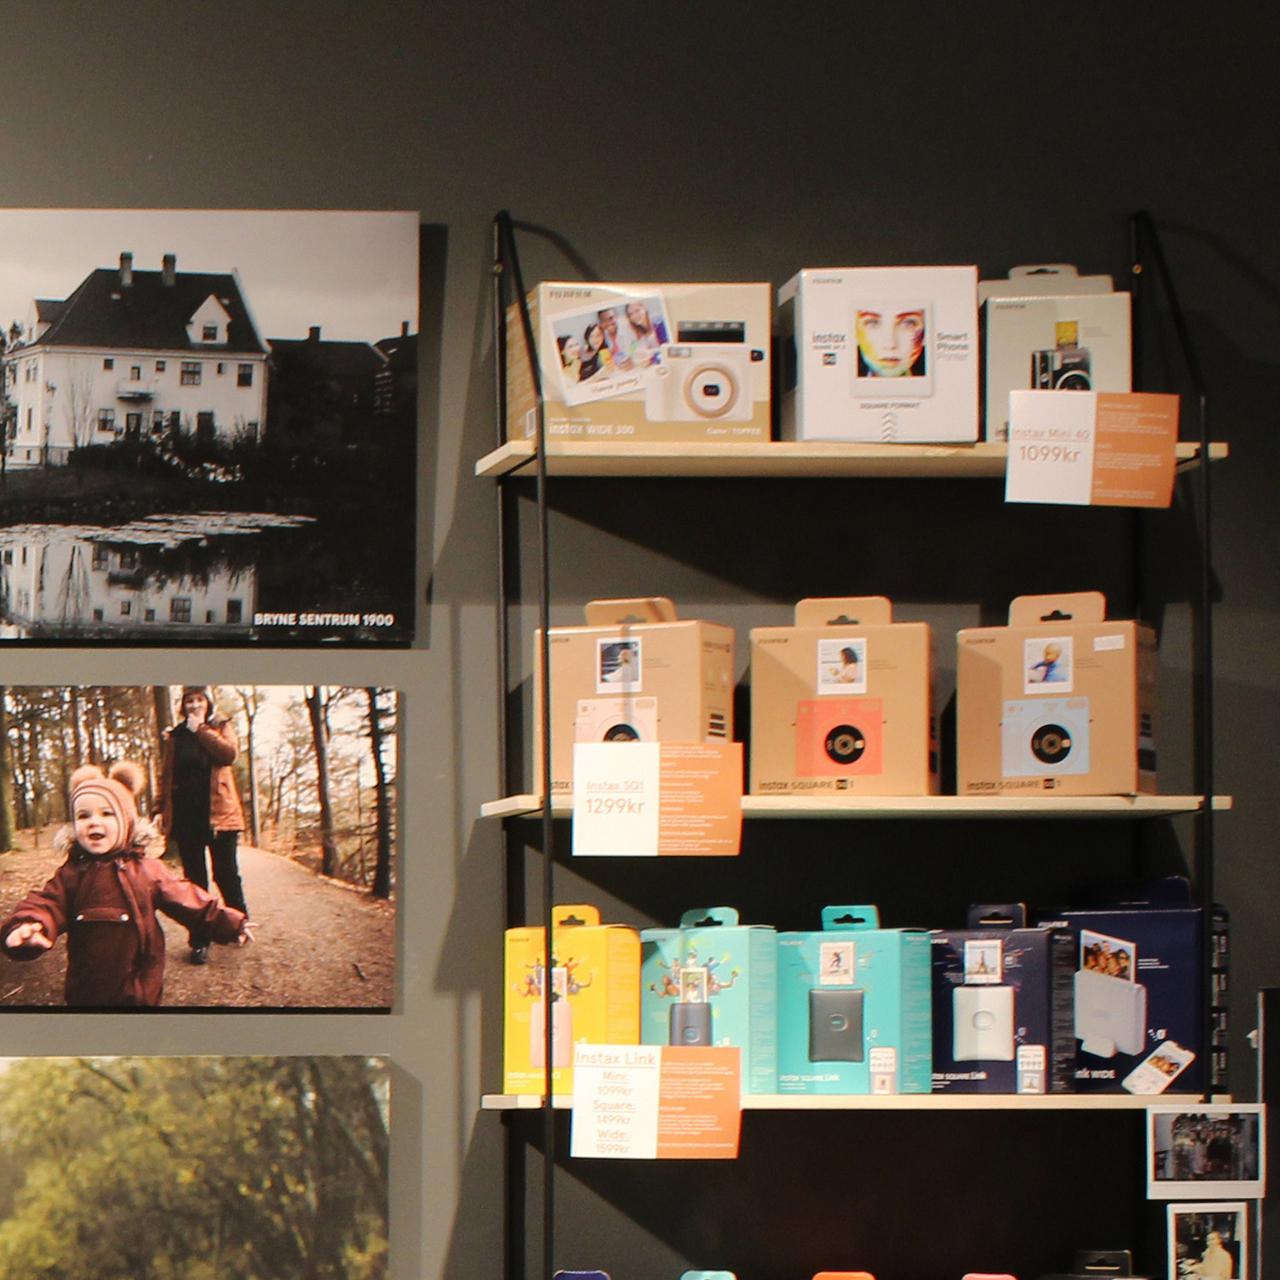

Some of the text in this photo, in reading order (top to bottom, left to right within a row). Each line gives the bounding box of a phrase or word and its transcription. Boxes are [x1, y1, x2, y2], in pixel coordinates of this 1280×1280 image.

[549, 290, 592, 299] FUJIFILM
[812, 332, 847, 343] instax
[937, 332, 968, 341] Smart
[937, 343, 969, 352] Phone
[549, 424, 635, 435] instax WIDE 300
[1012, 427, 1046, 441] Instax
[1048, 427, 1073, 440] Mini
[1020, 444, 1081, 463] 1099kr
[254, 612, 394, 626] BRYNE SENTRUM 1900
[586, 780, 645, 792] Instax SQ1
[760, 781, 834, 790] instax SQUARE
[967, 780, 1040, 790] instax SQUARE
[586, 798, 645, 815] 1299kr
[575, 1051, 656, 1066] Instax Link
[602, 1071, 630, 1082] Mini:
[1091, 1069, 1116, 1079] WIDE
[593, 1101, 636, 1113] Square:
[597, 1129, 631, 1140] Wide:
